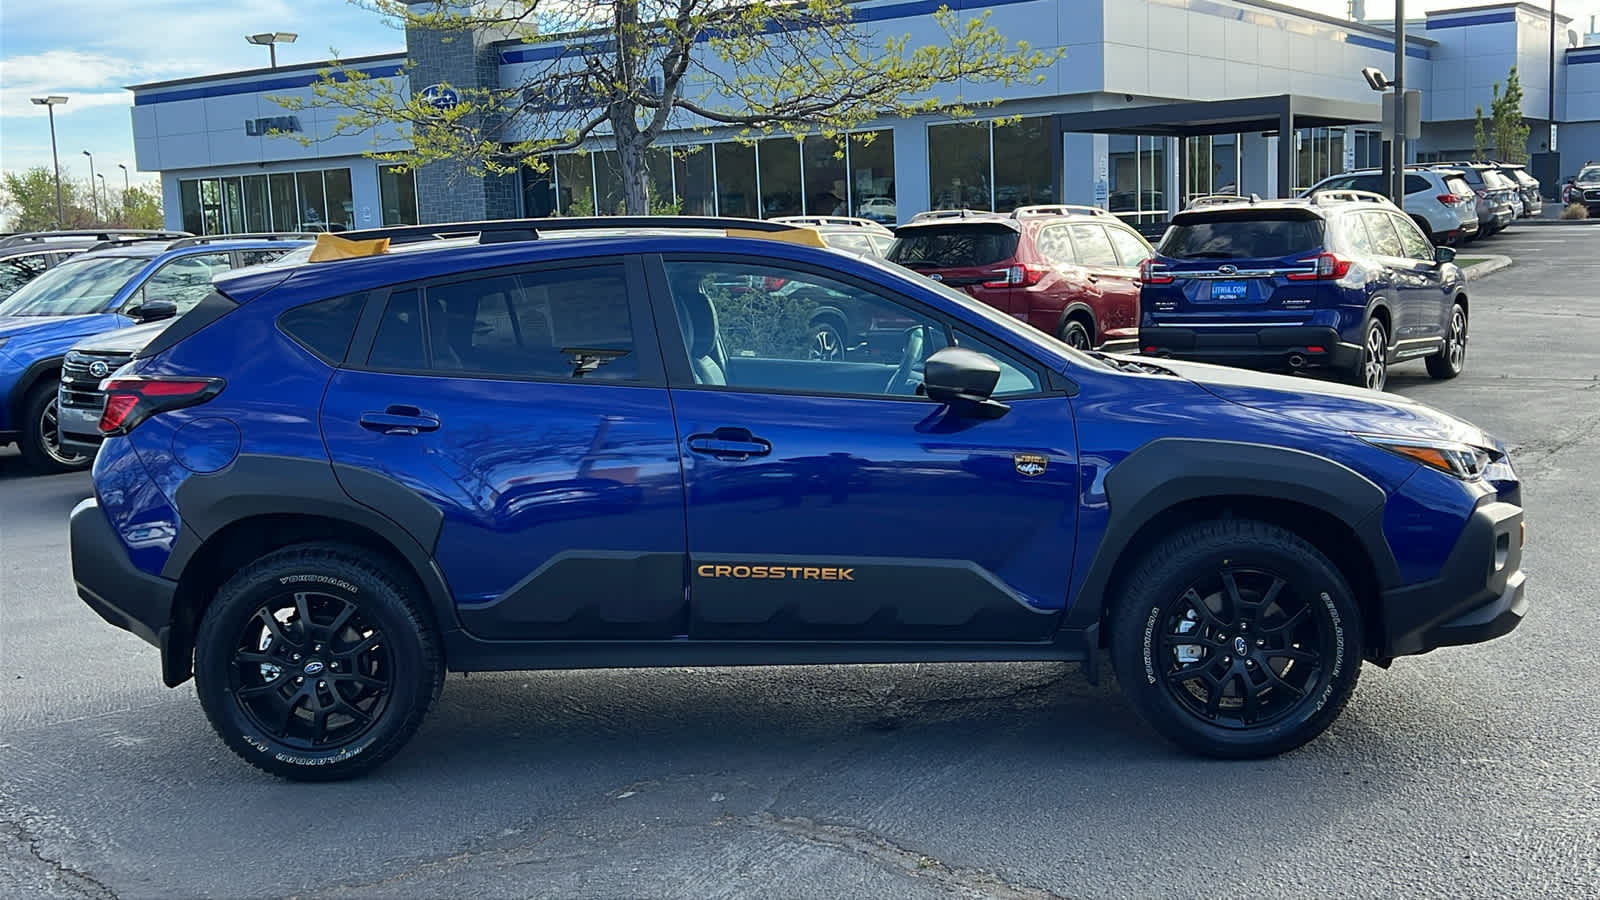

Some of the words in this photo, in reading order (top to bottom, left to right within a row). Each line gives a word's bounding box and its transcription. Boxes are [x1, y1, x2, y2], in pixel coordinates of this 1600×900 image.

[1211, 286, 1248, 294] LITHIA.COM
[697, 564, 855, 581] CROSSTREK
[279, 574, 358, 593] YOKOHAMA
[1143, 607, 1160, 685] YOKOHAMA
